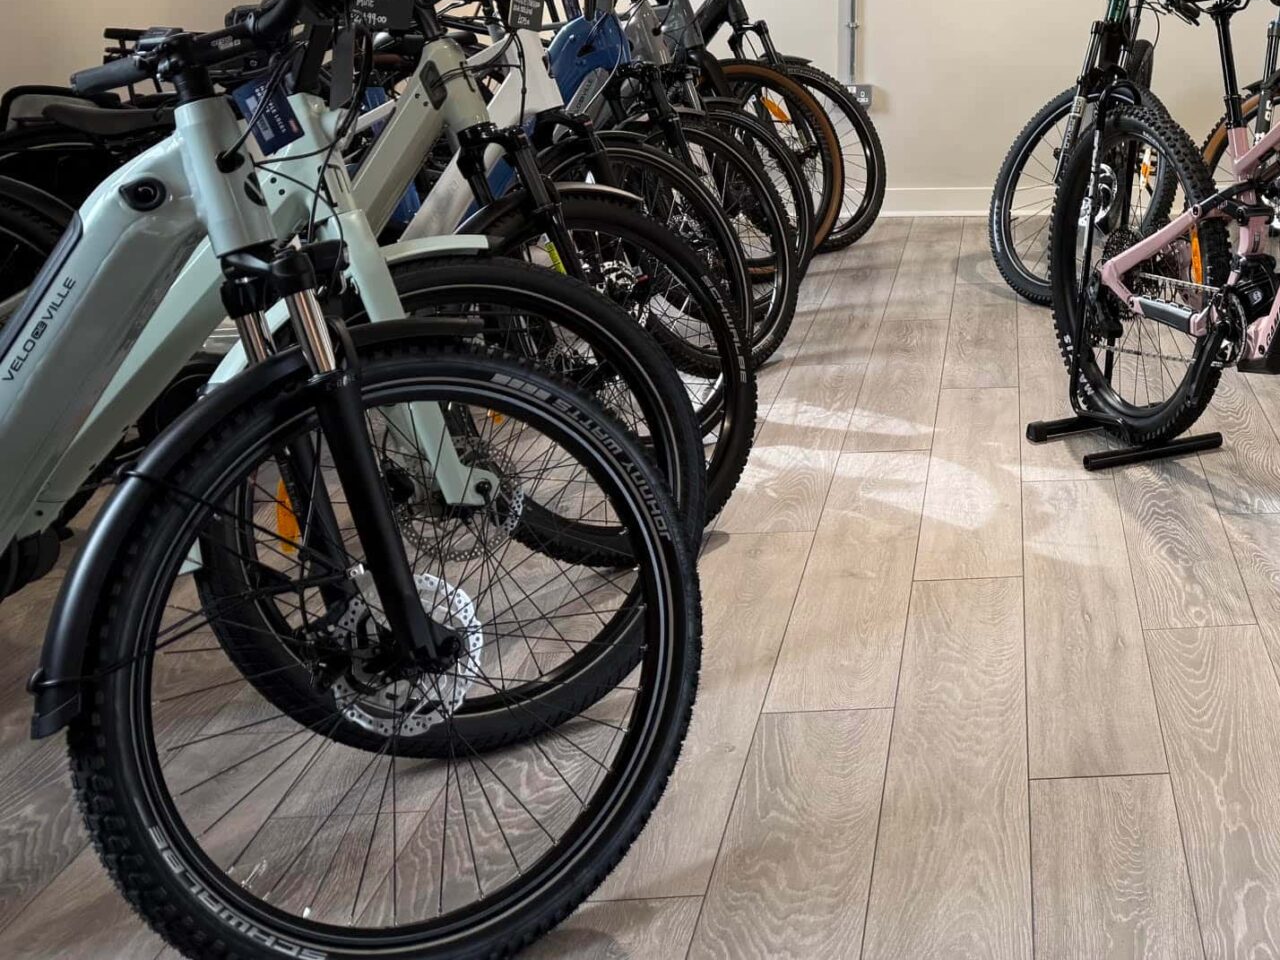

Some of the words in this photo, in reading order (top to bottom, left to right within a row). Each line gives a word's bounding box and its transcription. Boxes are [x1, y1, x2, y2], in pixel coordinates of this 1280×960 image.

[2, 338, 36, 381] VELO
[41, 276, 77, 320] VILLE
[701, 274, 747, 383] SCHWALBE
[551, 397, 623, 458] WATTS
[621, 460, 672, 542] JOHNNY
[149, 824, 328, 960] SCHWALBE
